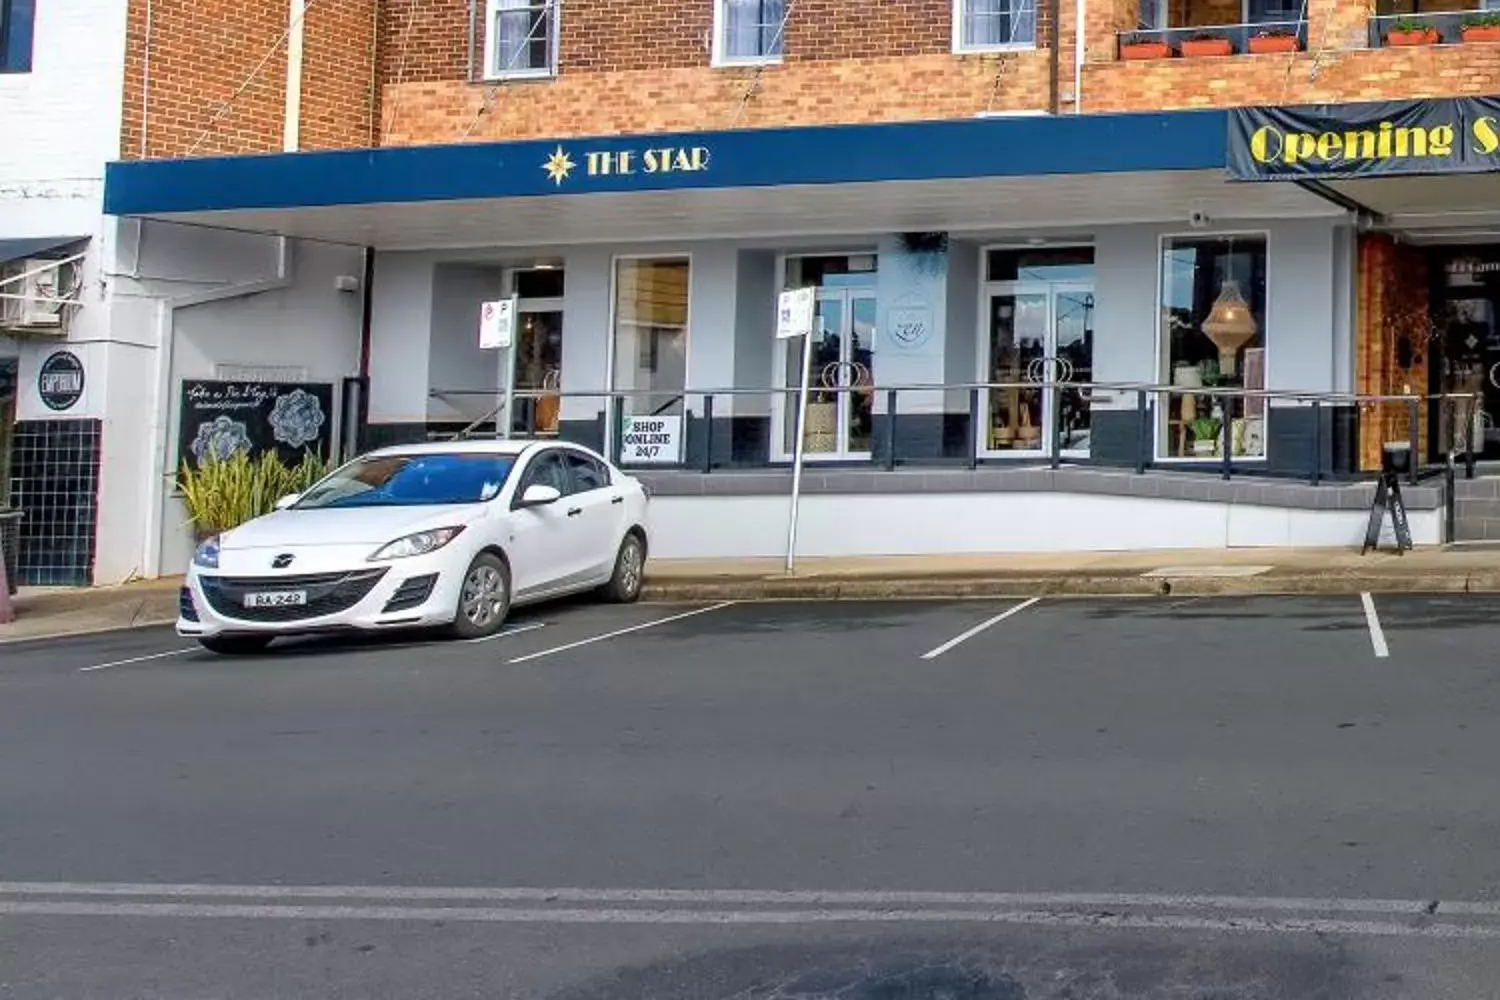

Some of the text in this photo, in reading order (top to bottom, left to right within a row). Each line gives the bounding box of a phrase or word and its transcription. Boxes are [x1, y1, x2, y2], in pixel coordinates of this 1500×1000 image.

[1250, 121, 1453, 164] Opening
[584, 146, 712, 177] THE STAR
[633, 421, 665, 432] SHOP
[625, 434, 670, 444] ONLINE
[635, 445, 660, 458] 24/7
